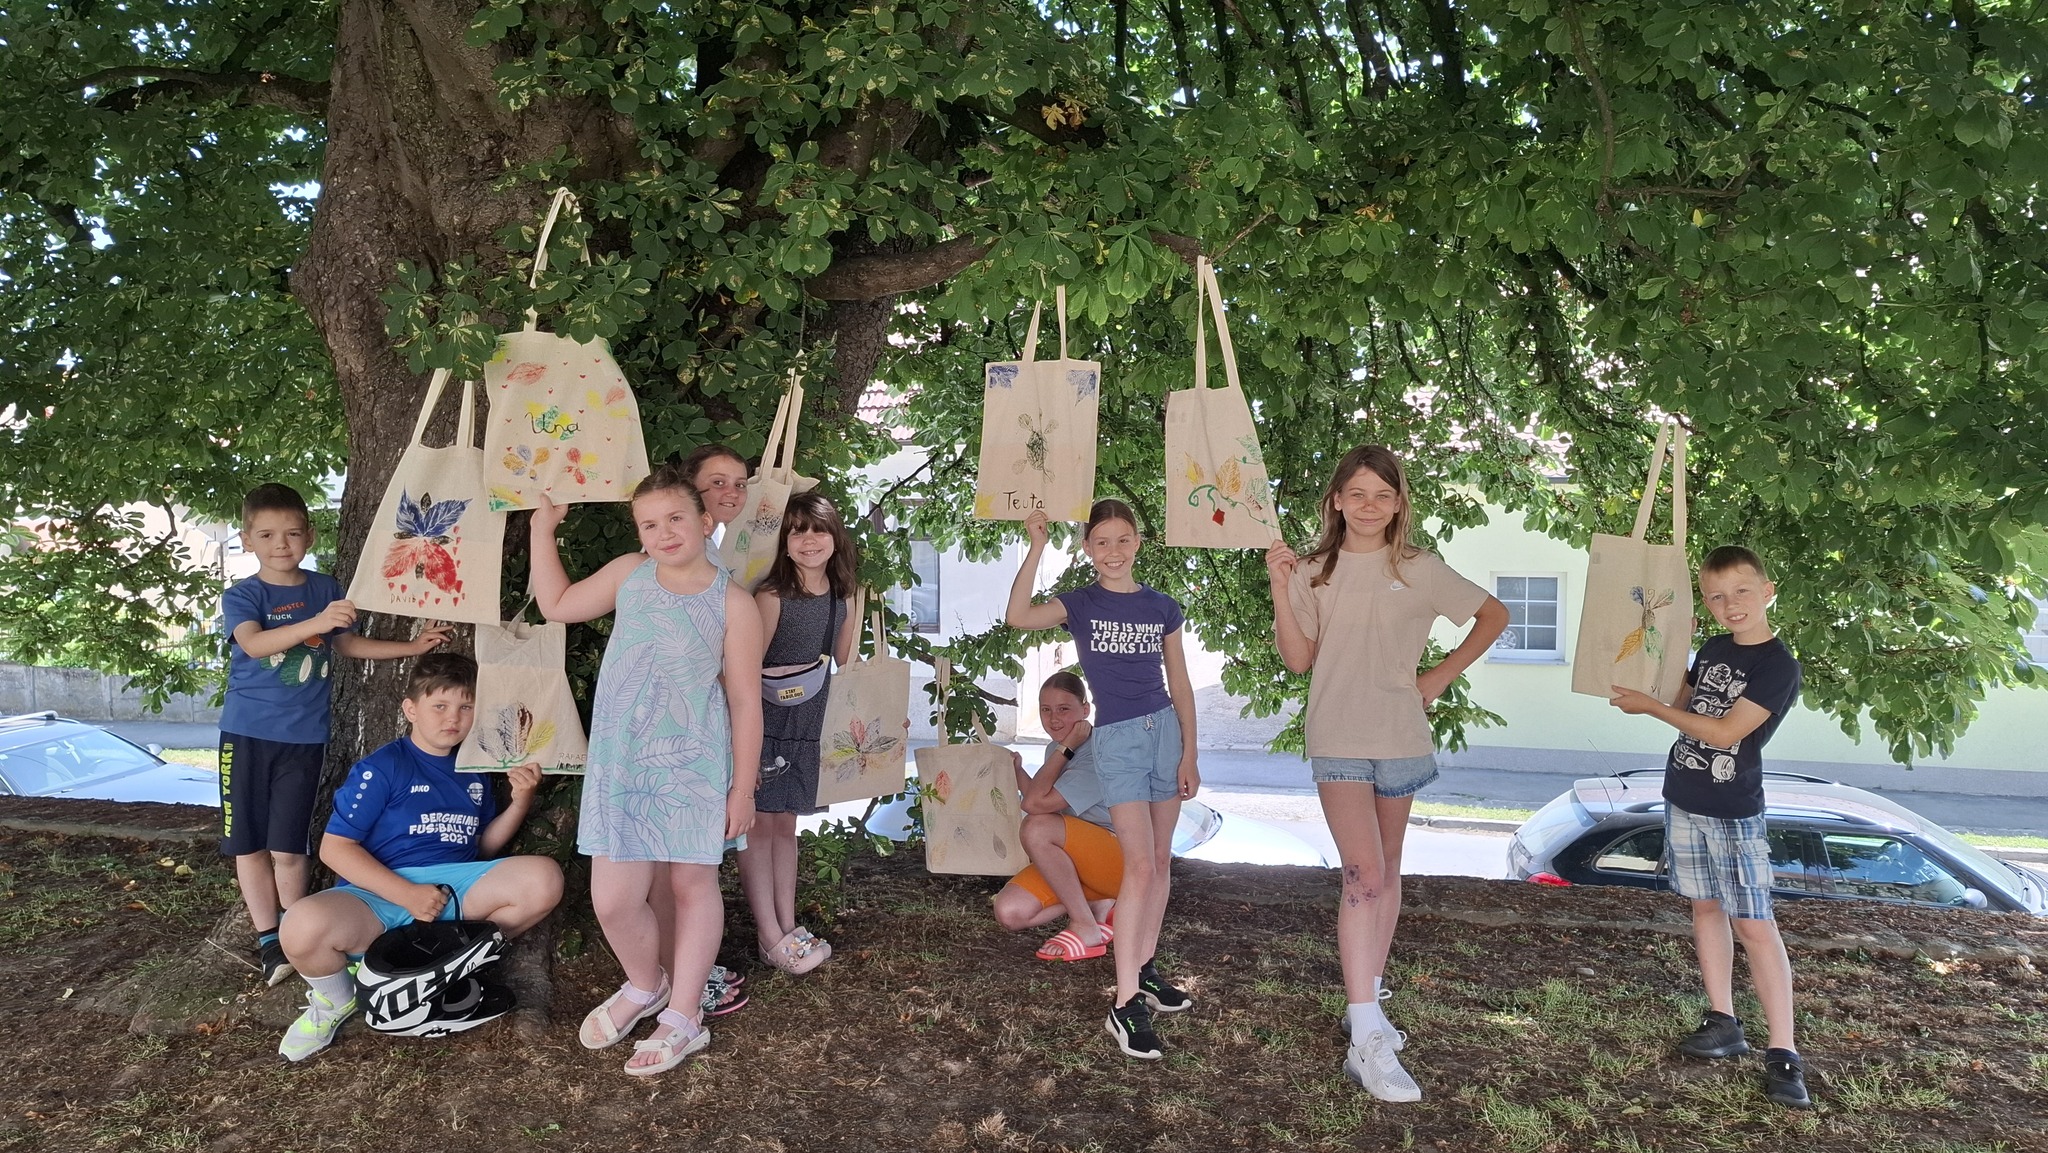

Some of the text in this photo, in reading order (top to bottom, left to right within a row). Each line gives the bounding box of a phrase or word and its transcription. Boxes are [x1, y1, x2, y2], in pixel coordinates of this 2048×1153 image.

[1003, 490, 1046, 511] Teuta
[266, 613, 293, 621] TRUCK
[1090, 619, 1164, 634] THIS IS WHAT
[1101, 630, 1155, 643] PERFECT
[1090, 640, 1163, 654] LOOKS LIKE
[780, 692, 803, 700] FABULOUS
[559, 752, 587, 761] RAFAE
[220, 751, 234, 796] YORK
[410, 784, 430, 794] JAKO
[223, 800, 233, 838] NEW
[440, 832, 468, 845] 2021
